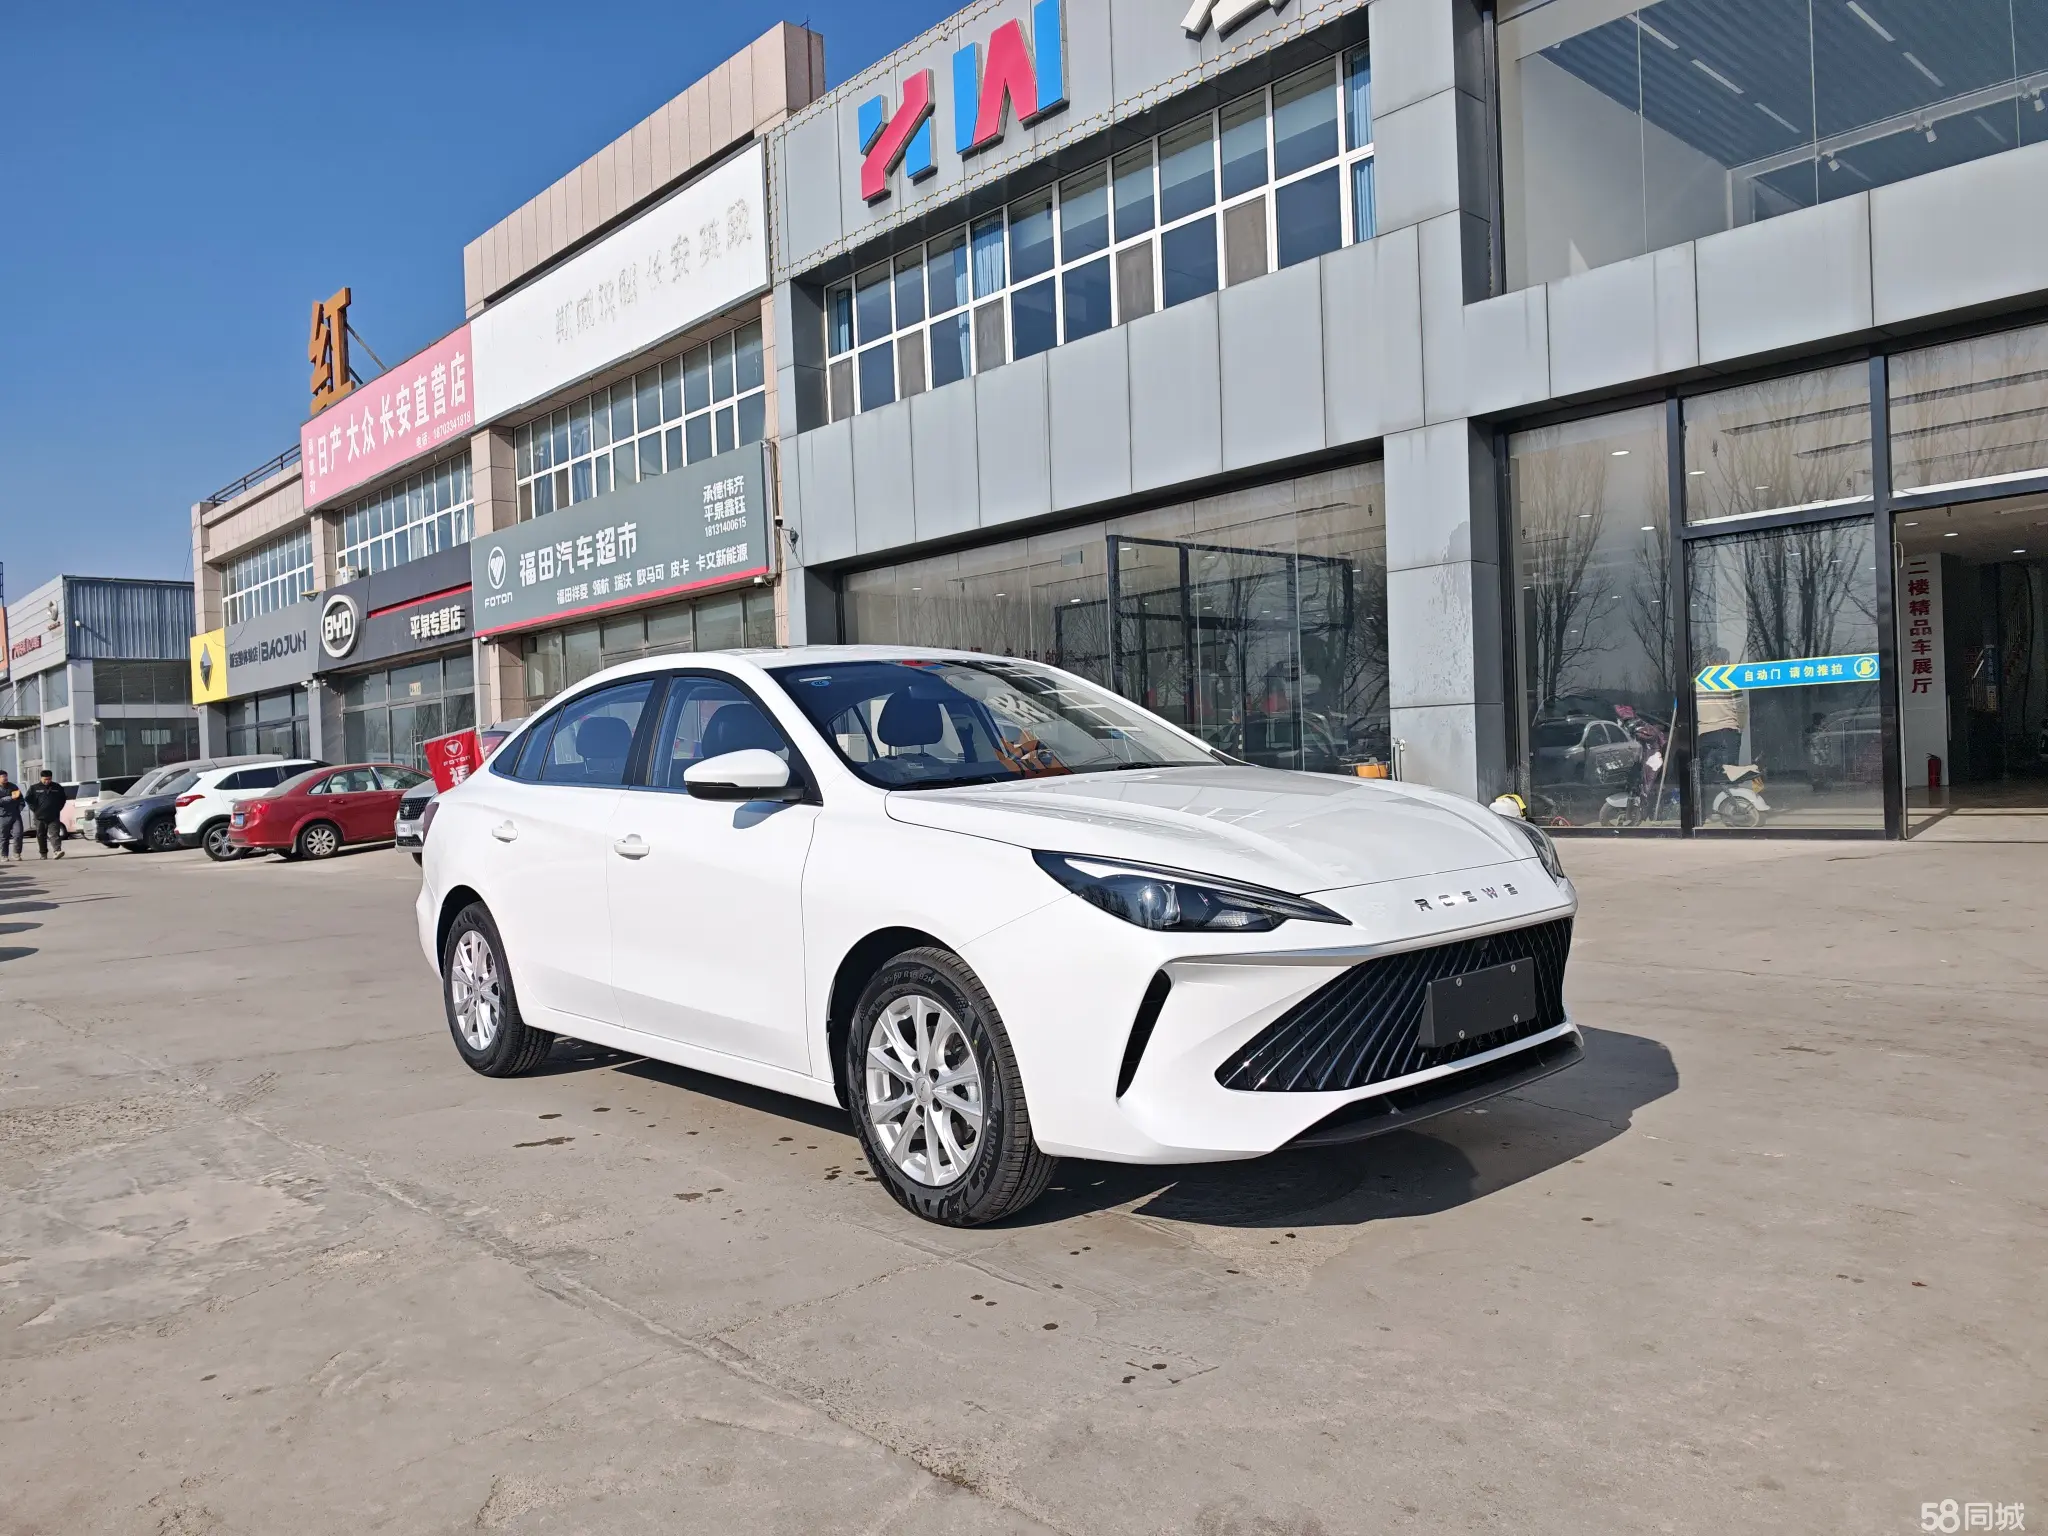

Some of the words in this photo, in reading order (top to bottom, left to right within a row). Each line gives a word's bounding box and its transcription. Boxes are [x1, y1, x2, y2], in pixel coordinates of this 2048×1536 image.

[317, 423, 342, 477] 日产
[346, 406, 376, 463] 大众
[380, 351, 466, 446] 长安直营店
[703, 475, 745, 503] 承德伟齐
[703, 495, 746, 523] 平泉鑫钰
[704, 516, 747, 538] 18131400615
[519, 521, 638, 588] 福田汽车超市
[556, 583, 589, 605] 福田祥菱
[636, 563, 665, 586] 欧马可
[670, 558, 690, 579] 皮卡
[695, 542, 749, 572] 卡文新能源
[484, 591, 513, 609] FOTON
[324, 610, 352, 642] BYD
[410, 605, 463, 640] 平泉专营店
[1907, 560, 1933, 694] 二楼精品车展厅
[260, 629, 307, 662] BAOJUN
[1744, 668, 1781, 682] 自动门
[1789, 663, 1844, 679] 请勿推拉
[1414, 883, 1519, 912] ROEWE
